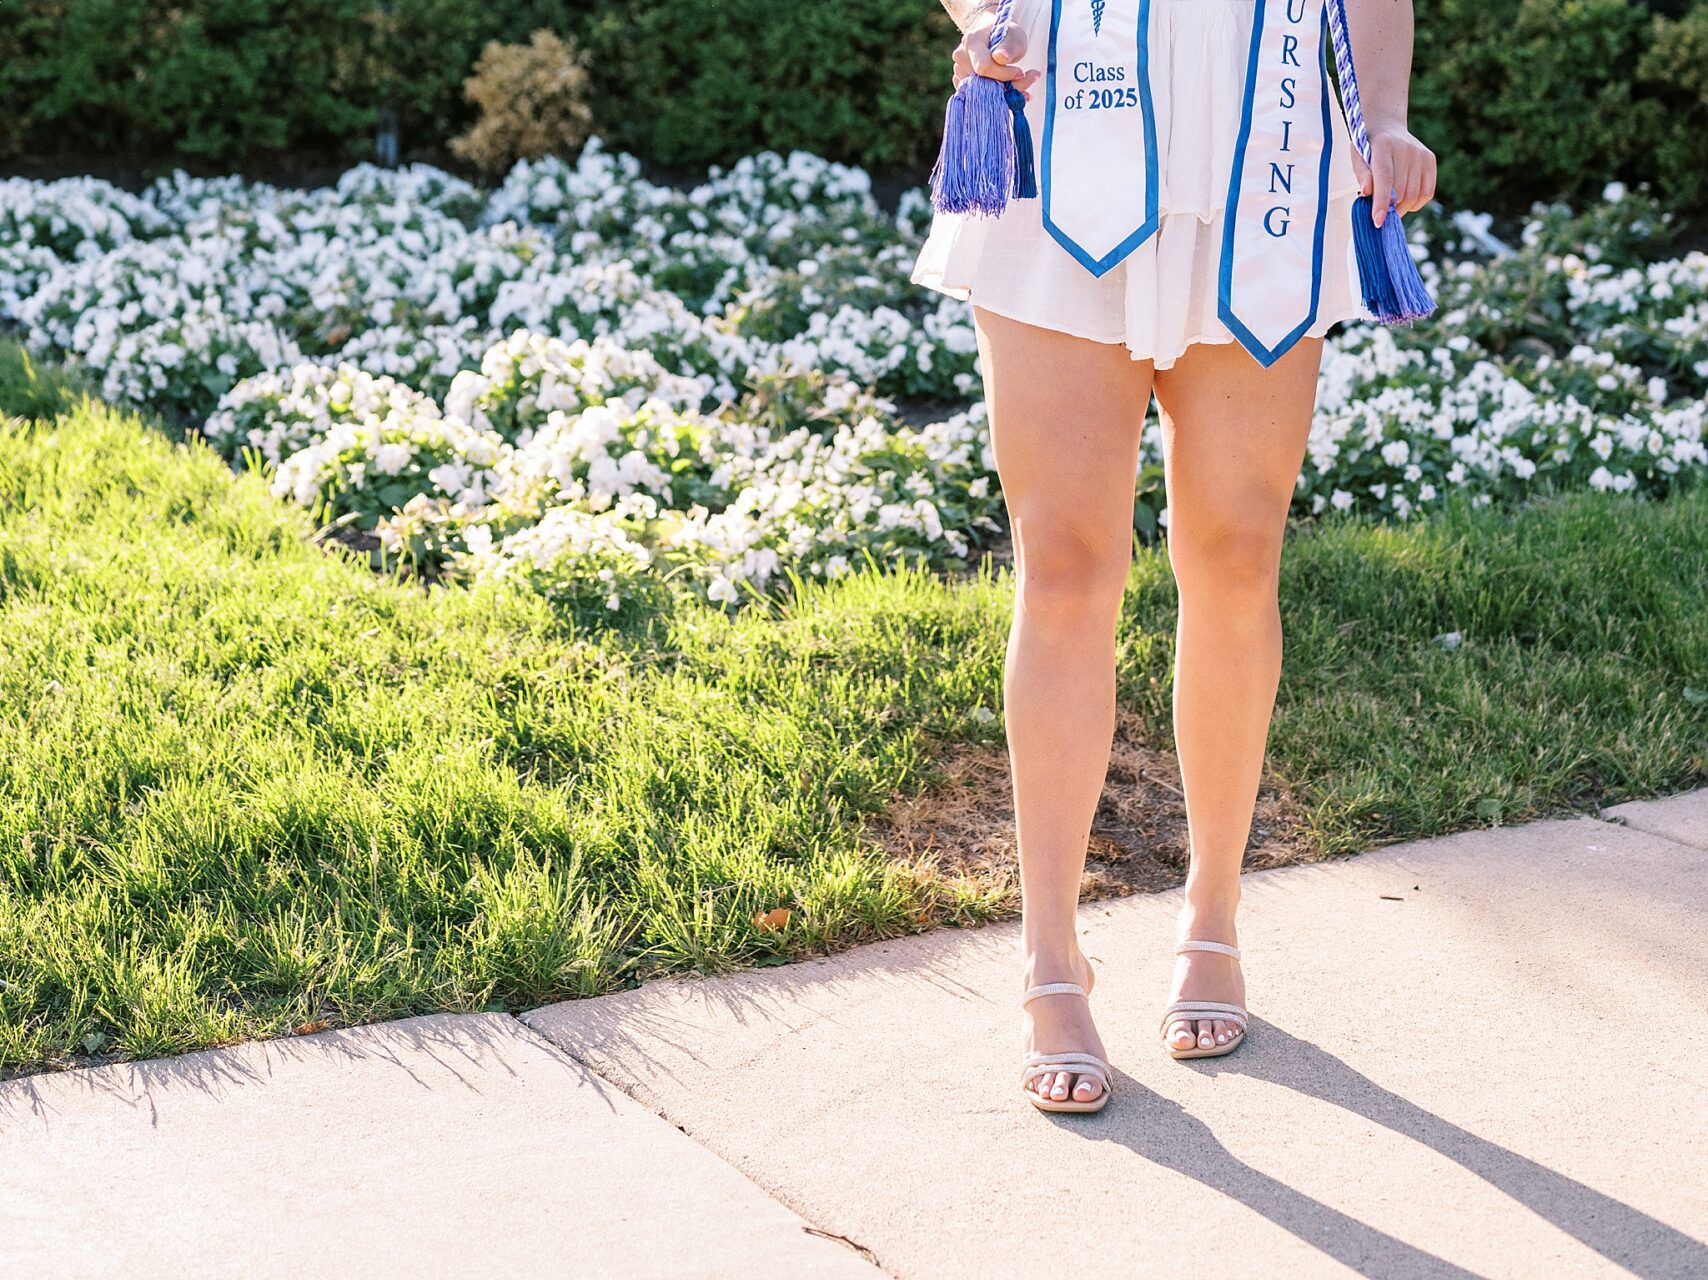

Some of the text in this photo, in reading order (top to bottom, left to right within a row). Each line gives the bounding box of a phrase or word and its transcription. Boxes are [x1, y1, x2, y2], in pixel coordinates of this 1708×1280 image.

[1073, 61, 1125, 83] Class
[1064, 87, 1138, 110] of 2025
